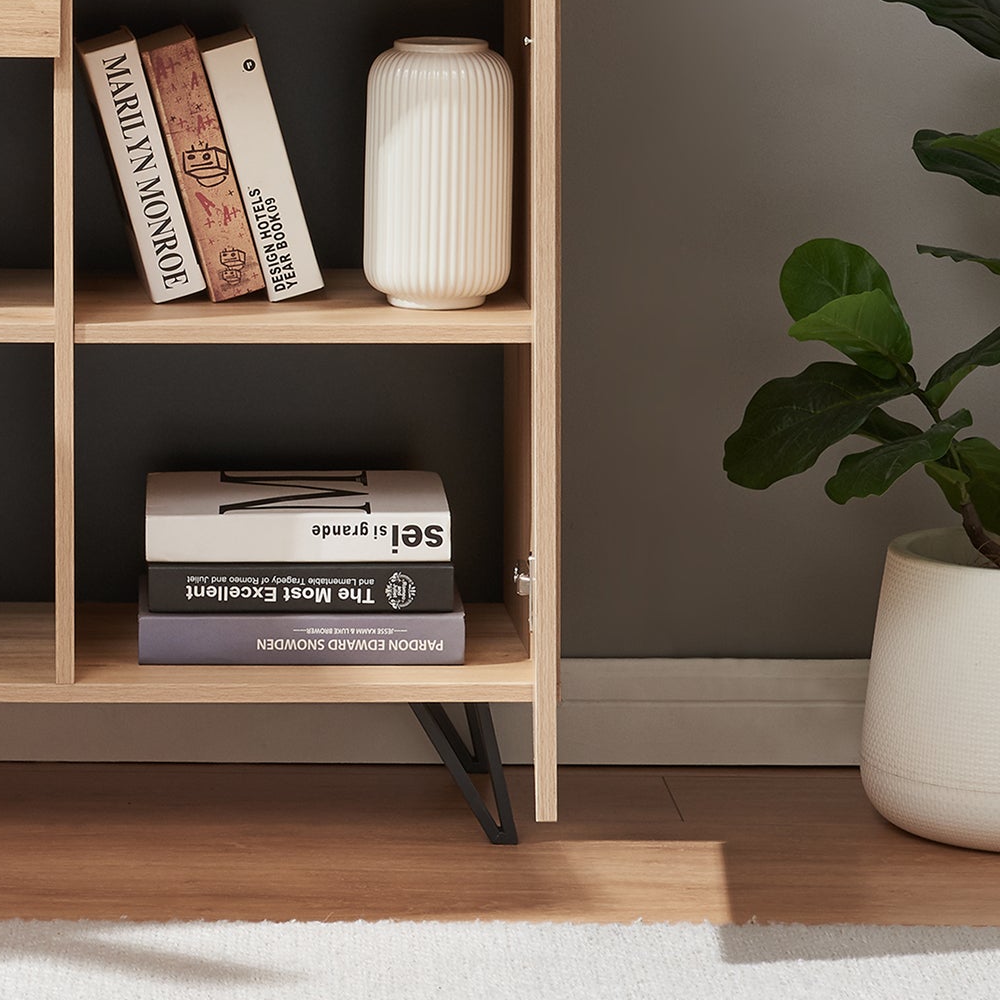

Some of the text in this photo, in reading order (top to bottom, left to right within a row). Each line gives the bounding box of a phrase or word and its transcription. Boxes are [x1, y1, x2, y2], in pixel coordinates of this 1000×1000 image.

[103, 53, 189, 289] MARILYN MONROE
[248, 188, 286, 292] DESIGN HOTELS
[279, 253, 298, 290] YEAR
[311, 521, 444, 554] sei si grande
[187, 575, 209, 583] Juliet
[229, 577, 259, 585] Romeo
[261, 577, 270, 585] of
[271, 576, 306, 586] Tragedy
[308, 577, 357, 586] Lamentable
[359, 578, 375, 586] and
[185, 584, 376, 604] The Most Excellent
[257, 638, 443, 651] PARDON EDWARD SNOWDEN
